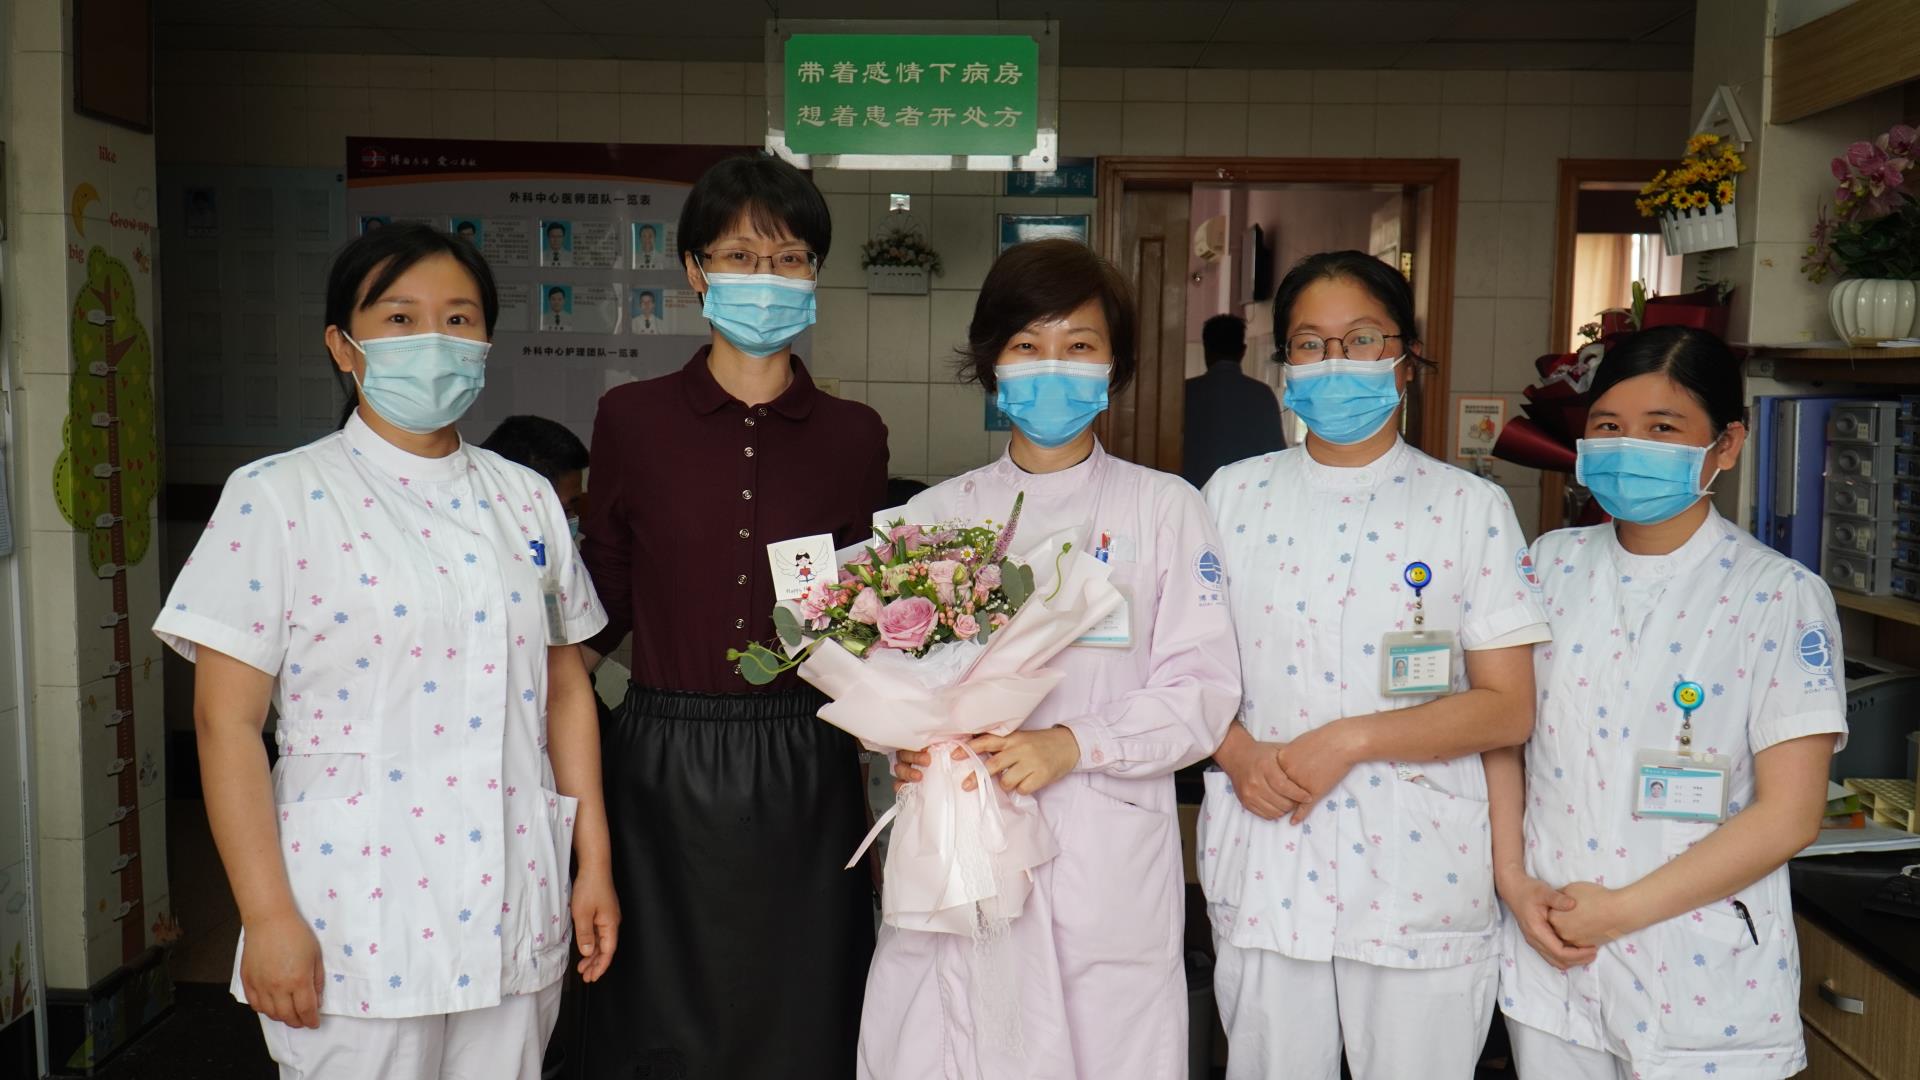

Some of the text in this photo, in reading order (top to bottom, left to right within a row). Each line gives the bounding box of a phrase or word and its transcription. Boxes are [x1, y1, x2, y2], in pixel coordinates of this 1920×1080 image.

[798, 61, 1023, 85] 带着感情下病房
[796, 105, 1023, 128] 想着患者开处方
[99, 146, 116, 164] like
[510, 192, 651, 206] 外科中心医师团队一览表
[68, 244, 84, 263] big
[522, 346, 639, 358] 外科中心护理团队一览表
